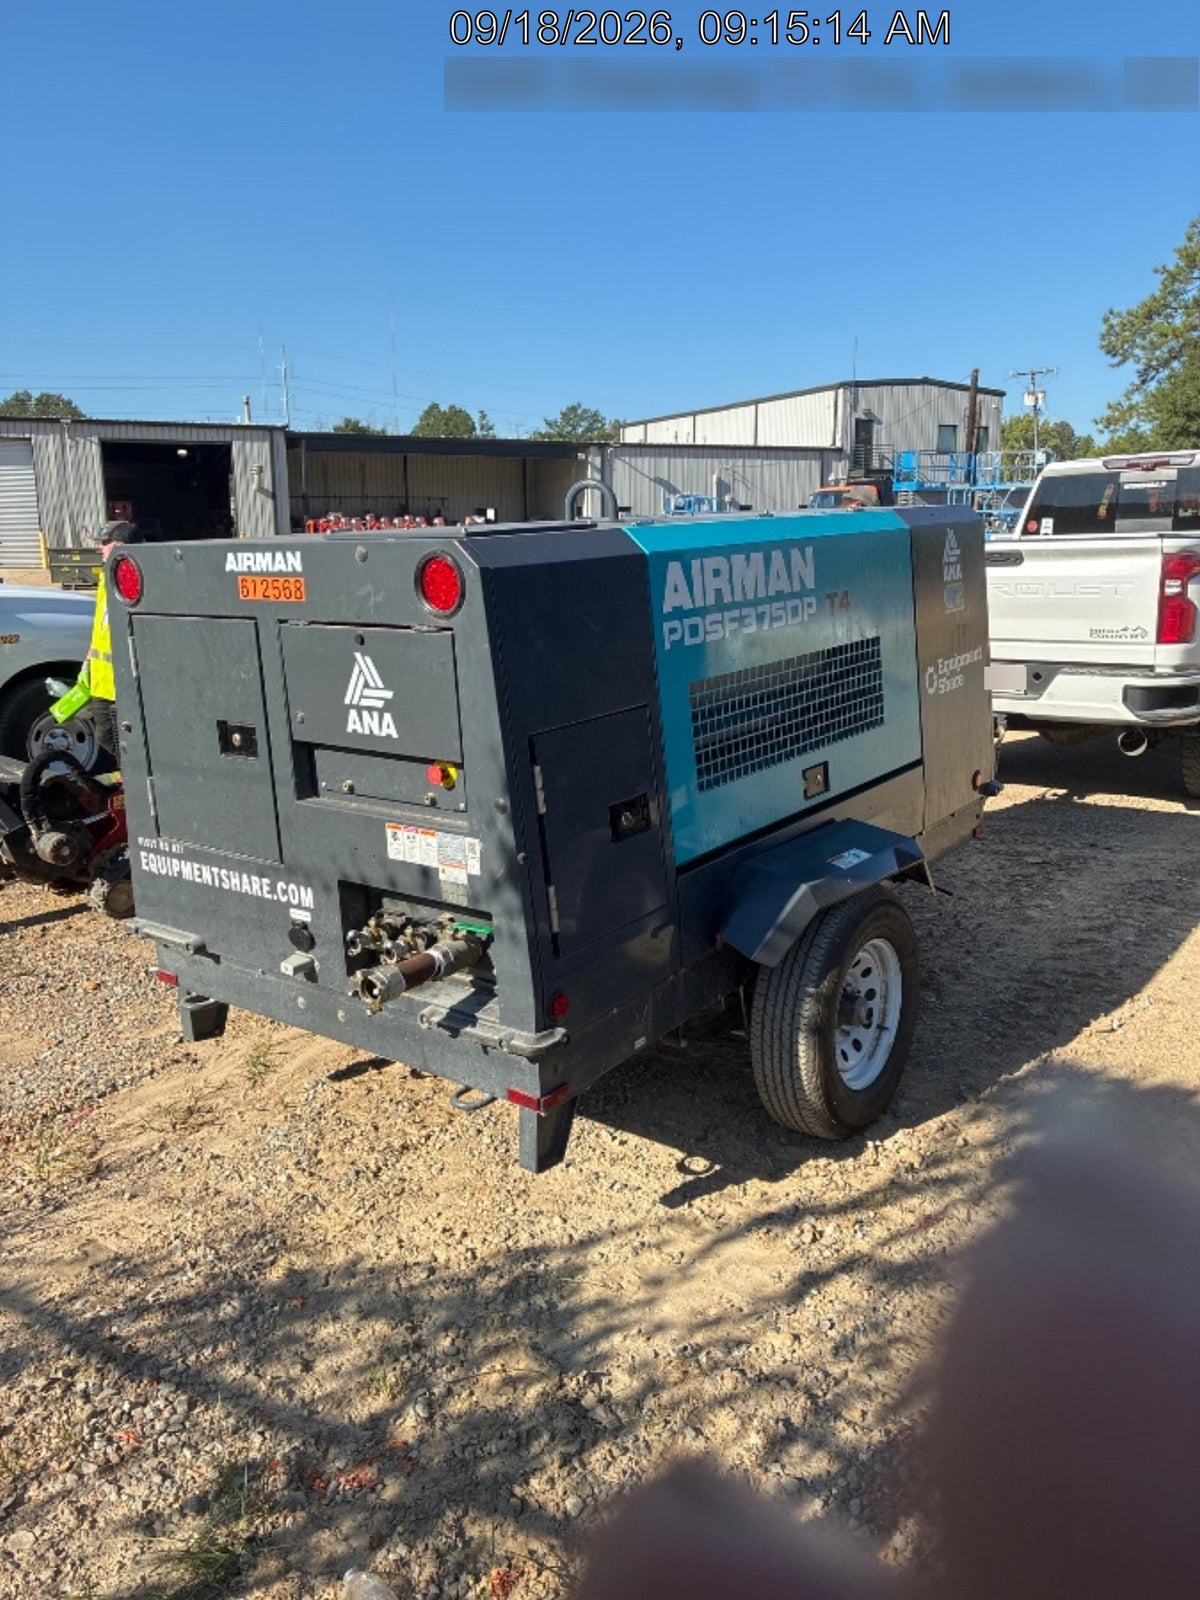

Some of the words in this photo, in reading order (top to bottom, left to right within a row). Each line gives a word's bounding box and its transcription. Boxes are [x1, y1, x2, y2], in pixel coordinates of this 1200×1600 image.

[225, 551, 303, 572] AIRMAN
[662, 546, 816, 614] AIRMAN
[240, 577, 304, 600] 612568
[662, 596, 818, 650] PDSF375DP
[825, 590, 851, 616] T4
[345, 708, 399, 739] ANA
[139, 851, 315, 909] EQUIPMENTSHARE.COM
